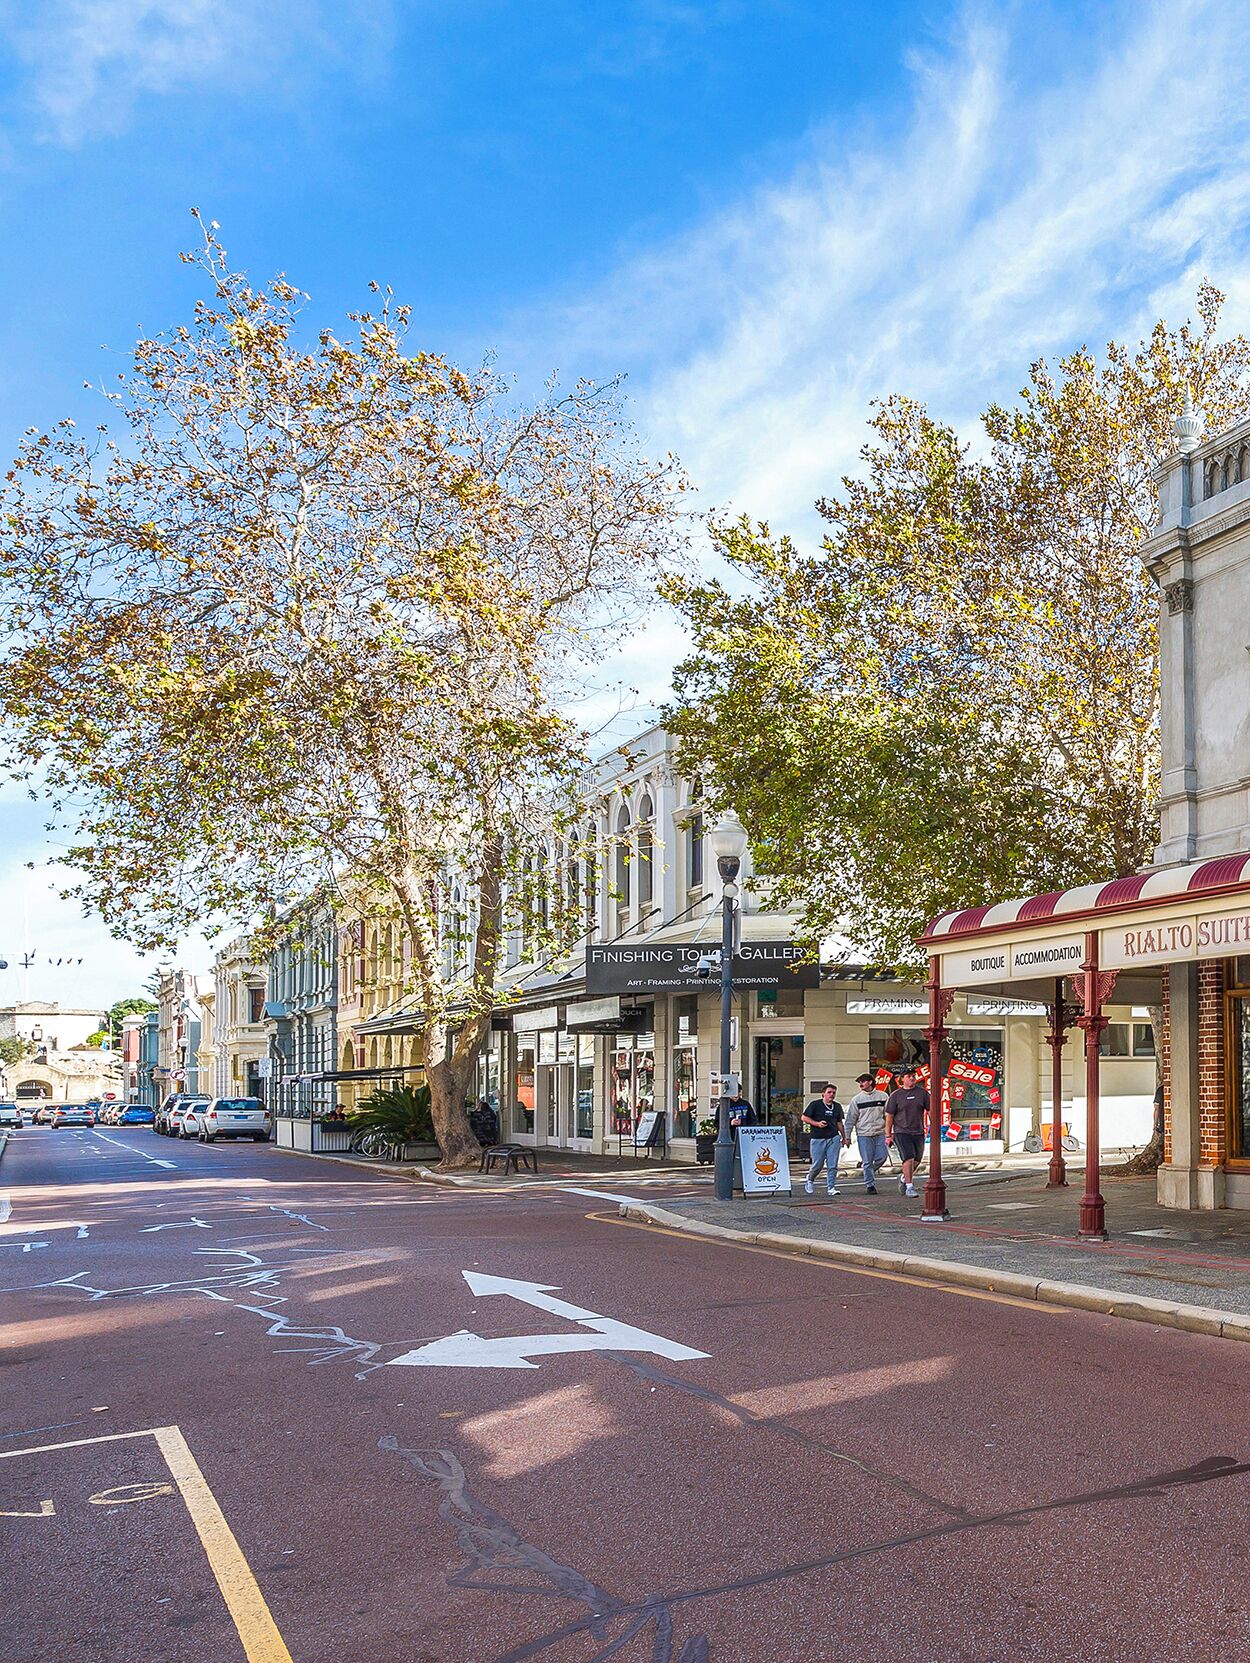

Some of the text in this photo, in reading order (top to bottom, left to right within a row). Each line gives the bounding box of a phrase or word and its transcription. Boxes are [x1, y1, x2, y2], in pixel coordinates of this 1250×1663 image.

[1123, 924, 1193, 957] RIALTO
[592, 950, 674, 963] FINISHING
[971, 945, 1083, 972] BOUTIQUE ACCOMMODATION
[732, 977, 779, 985] ESTORATION
[864, 998, 924, 1009] FRAMING
[982, 999, 1038, 1011] PRINTING
[620, 1009, 643, 1017] OUCH
[874, 1073, 891, 1085] Sale
[949, 1063, 993, 1083] Sale
[942, 1077, 950, 1126] SALE
